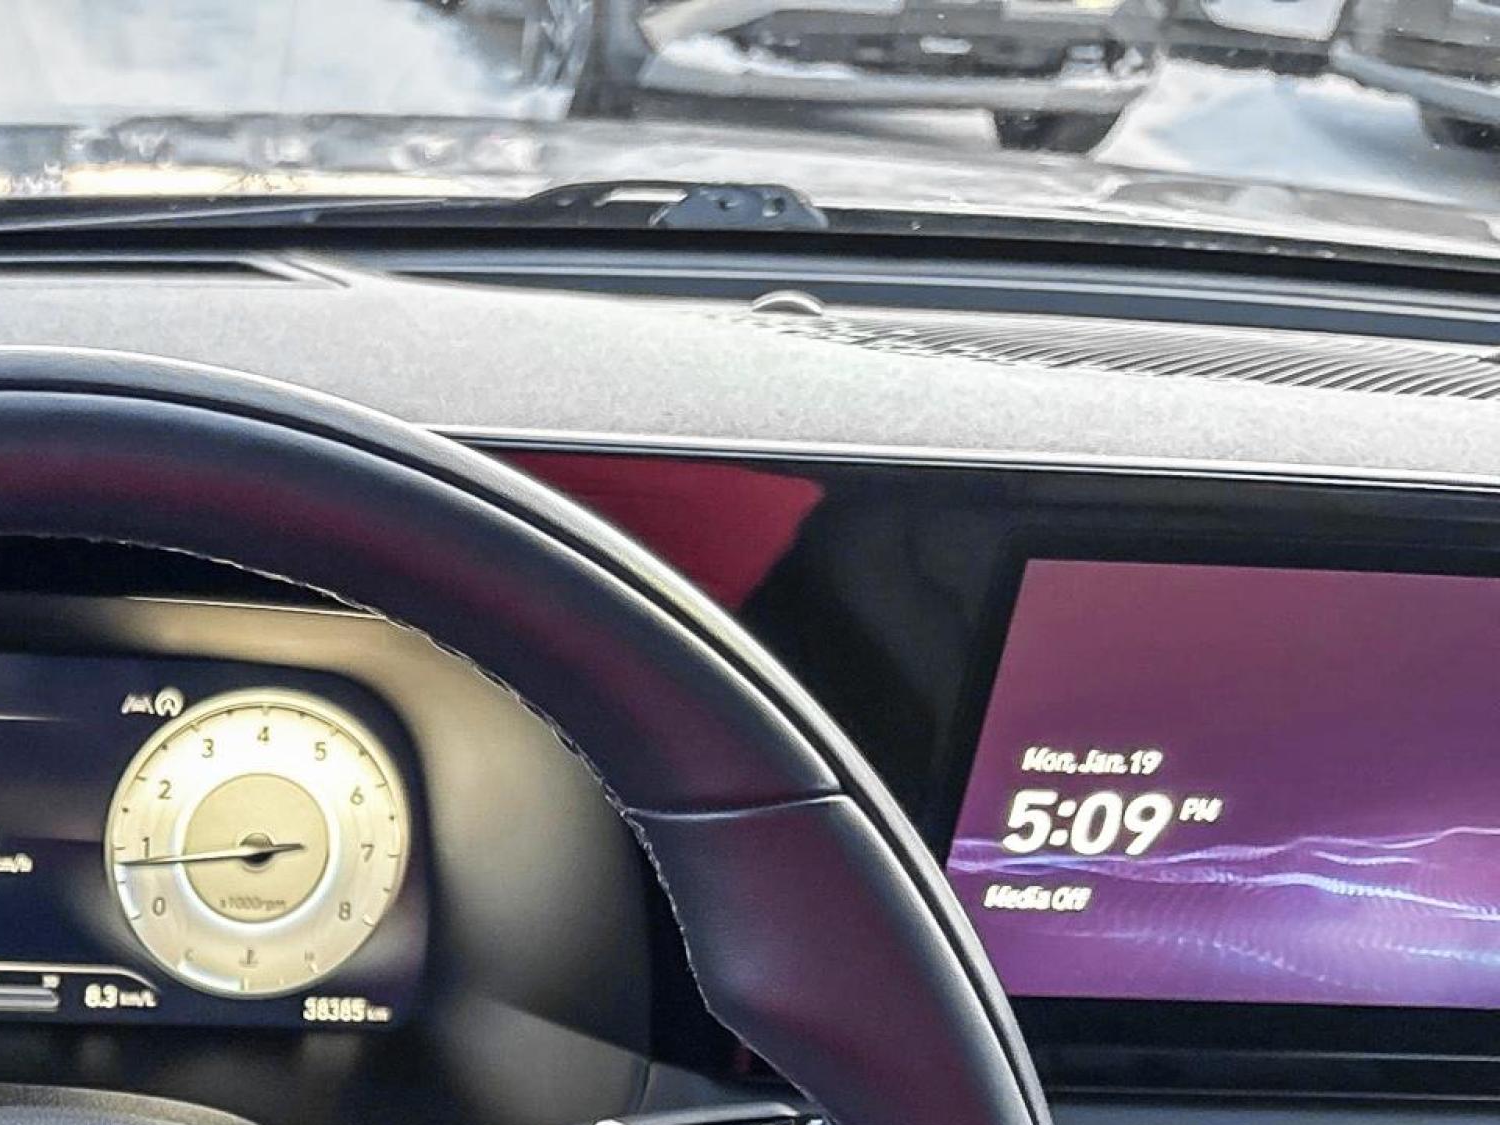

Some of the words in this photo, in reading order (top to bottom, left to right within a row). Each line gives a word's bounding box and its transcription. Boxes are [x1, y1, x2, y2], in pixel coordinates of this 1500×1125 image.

[256, 725, 271, 744] 4
[201, 738, 216, 759] 3
[314, 741, 328, 761] 5
[1130, 750, 1163, 774] 19
[158, 780, 172, 801] 2
[350, 786, 365, 806] 6
[1002, 790, 1173, 856] 5:09
[1179, 798, 1223, 822] PM
[141, 836, 152, 860] 1
[360, 843, 376, 863] 7
[152, 897, 166, 917] 0
[338, 901, 352, 922] 8
